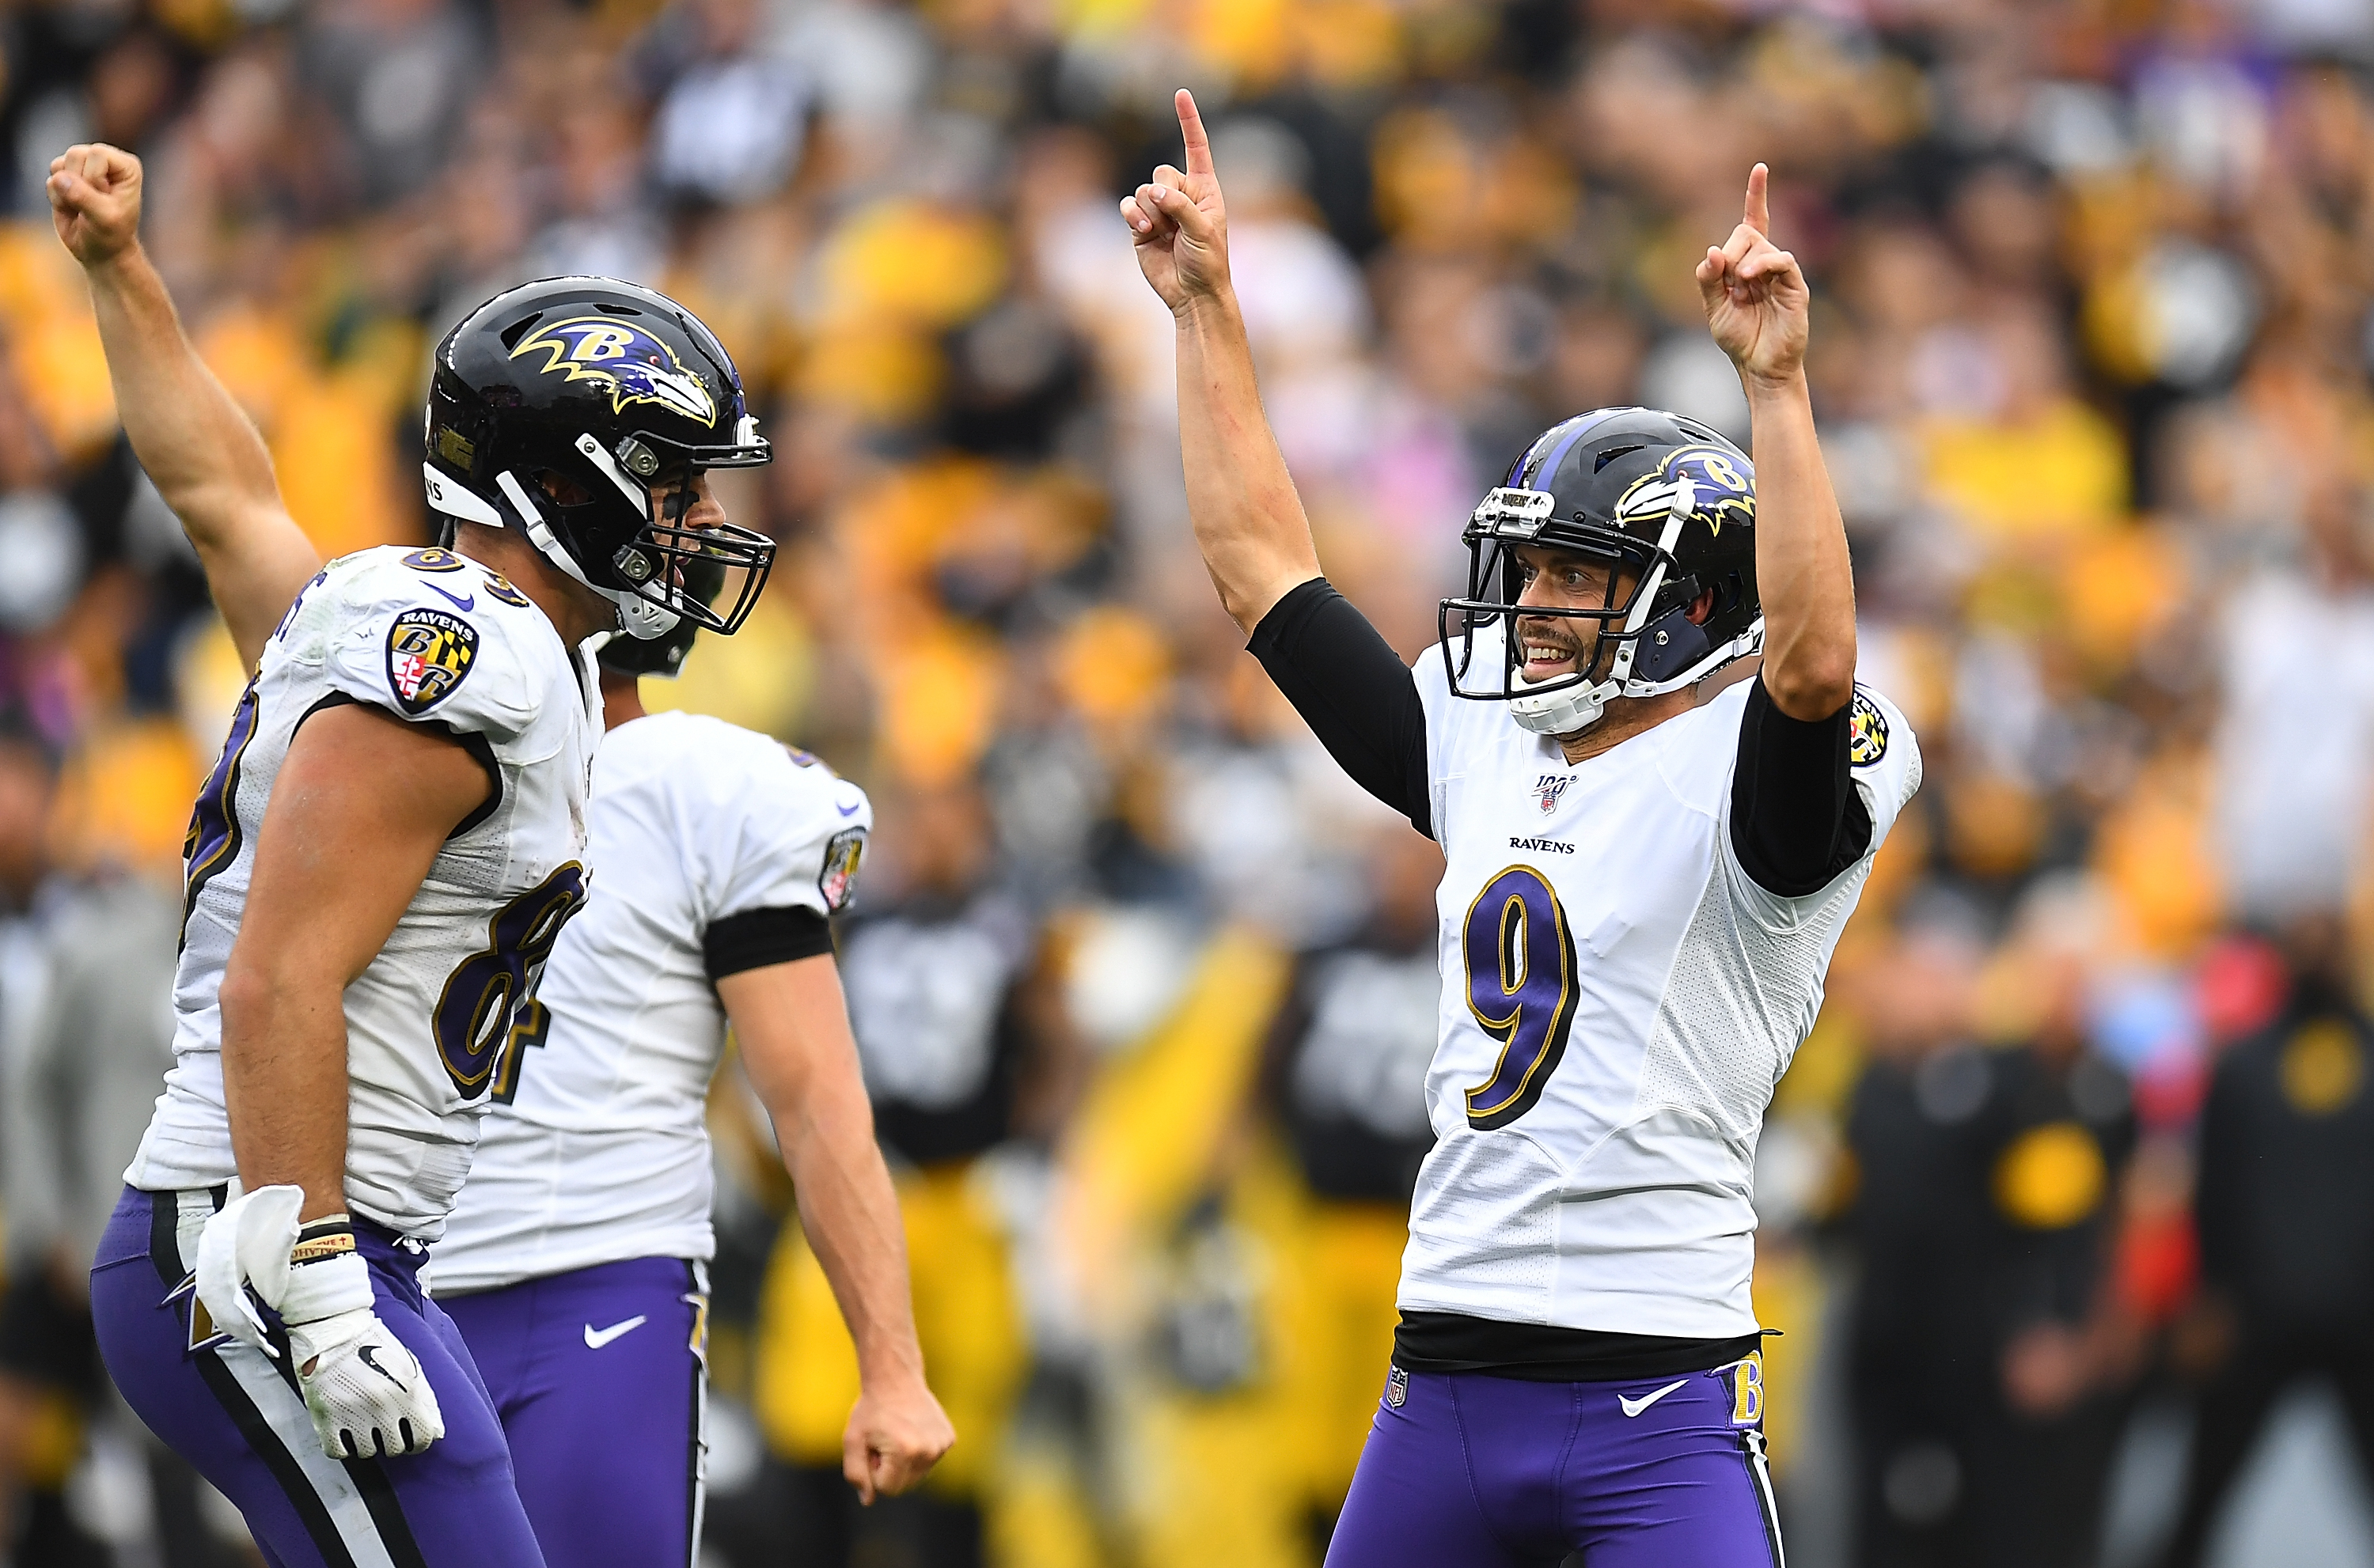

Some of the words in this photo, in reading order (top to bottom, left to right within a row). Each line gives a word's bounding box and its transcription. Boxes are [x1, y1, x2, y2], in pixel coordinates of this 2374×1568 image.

[557, 324, 635, 362] B
[1678, 452, 1747, 492] B
[396, 626, 437, 653] B
[402, 612, 474, 642] RAVENS
[1509, 837, 1575, 855] RAVENS
[1462, 864, 1580, 1131] 9
[1389, 1384, 1403, 1401] NFL
[1709, 1350, 1763, 1424] B
